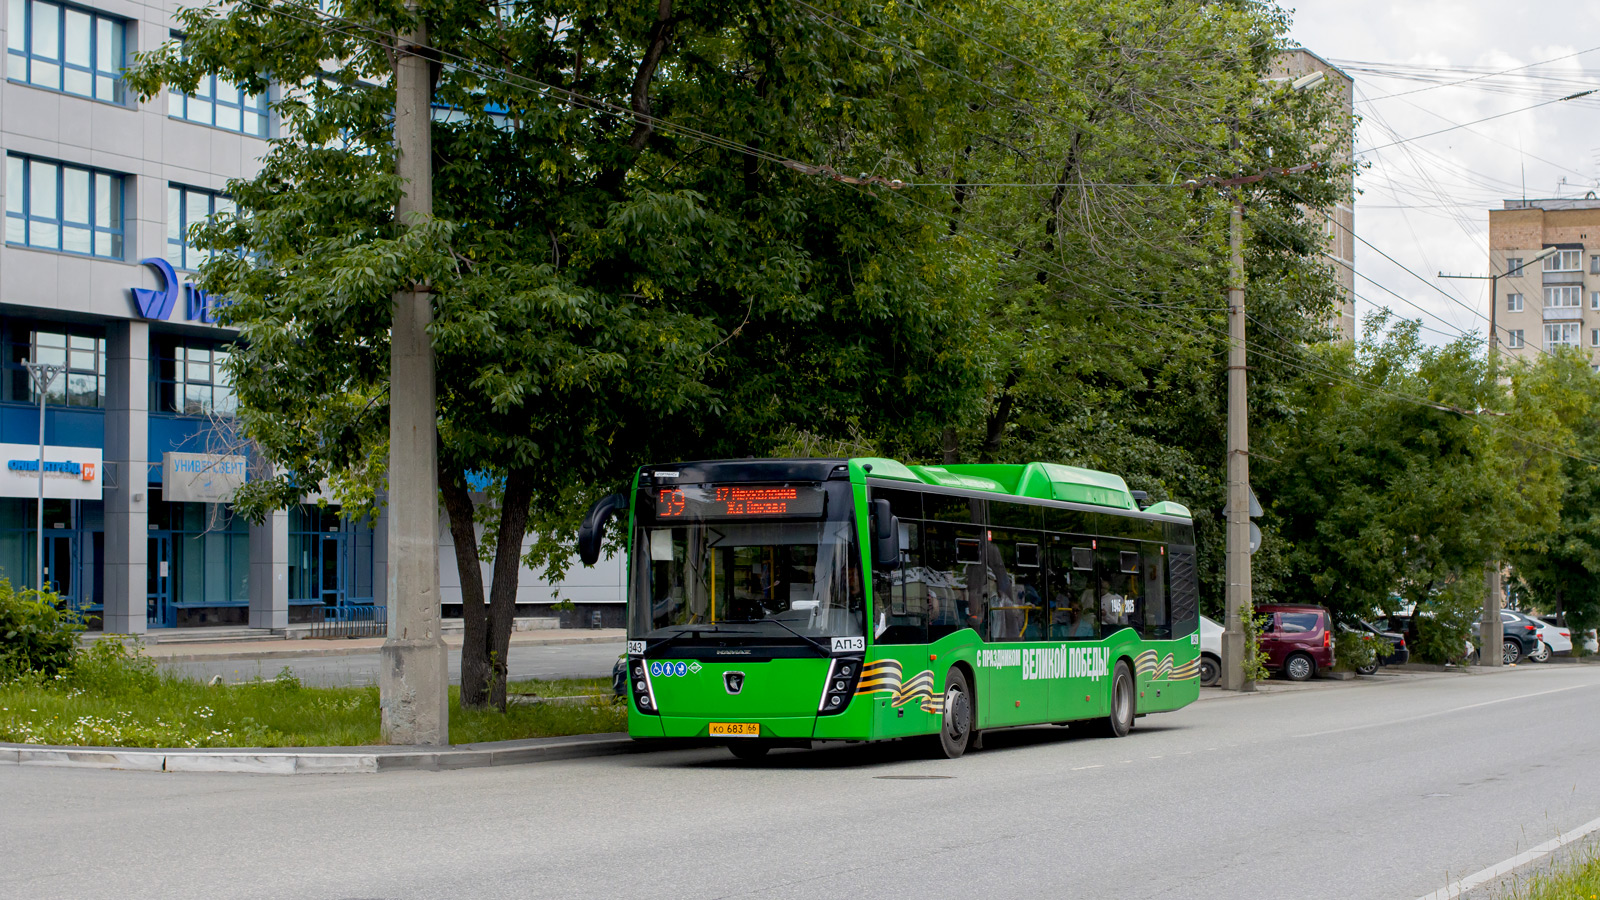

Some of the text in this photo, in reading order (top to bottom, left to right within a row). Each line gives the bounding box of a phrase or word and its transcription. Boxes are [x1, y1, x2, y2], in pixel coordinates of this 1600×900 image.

[716, 488, 729, 501] 17
[660, 489, 685, 516] 59
[628, 642, 642, 653] 343
[834, 639, 863, 650] АП-3
[977, 644, 1110, 682] С ПРАЗДНИКОМ ВЕЛИКОЙ ПОБЕДЫ!
[727, 724, 743, 734] 683
[747, 724, 757, 732] 66
